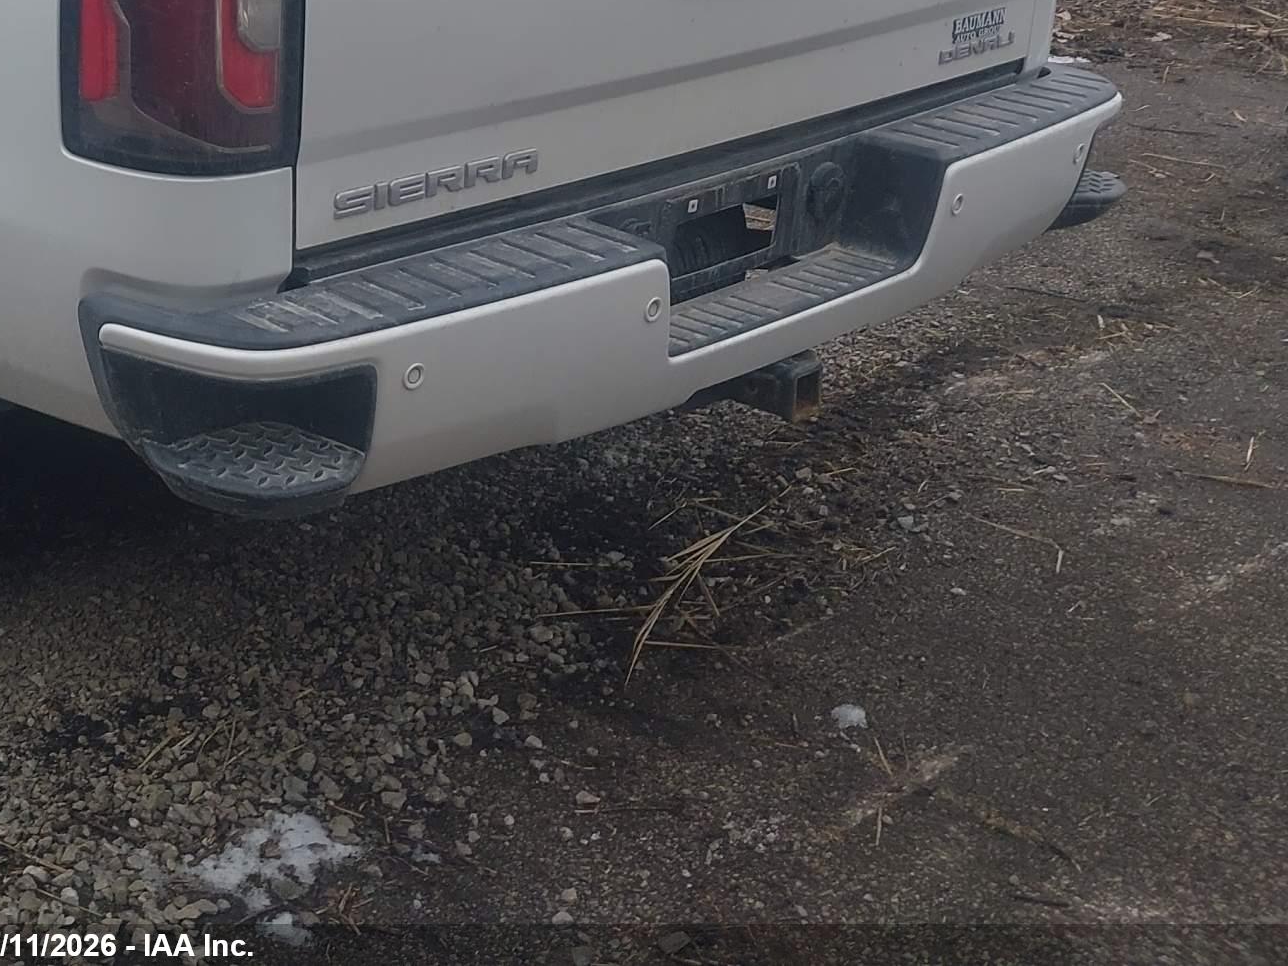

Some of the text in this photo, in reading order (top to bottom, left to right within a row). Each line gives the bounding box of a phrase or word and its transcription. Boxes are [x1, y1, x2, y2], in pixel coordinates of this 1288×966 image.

[955, 9, 1007, 34] BAUMANN
[955, 25, 1001, 43] AUTO GROU
[938, 30, 1014, 65] DENALI
[333, 148, 538, 218] SIERRA
